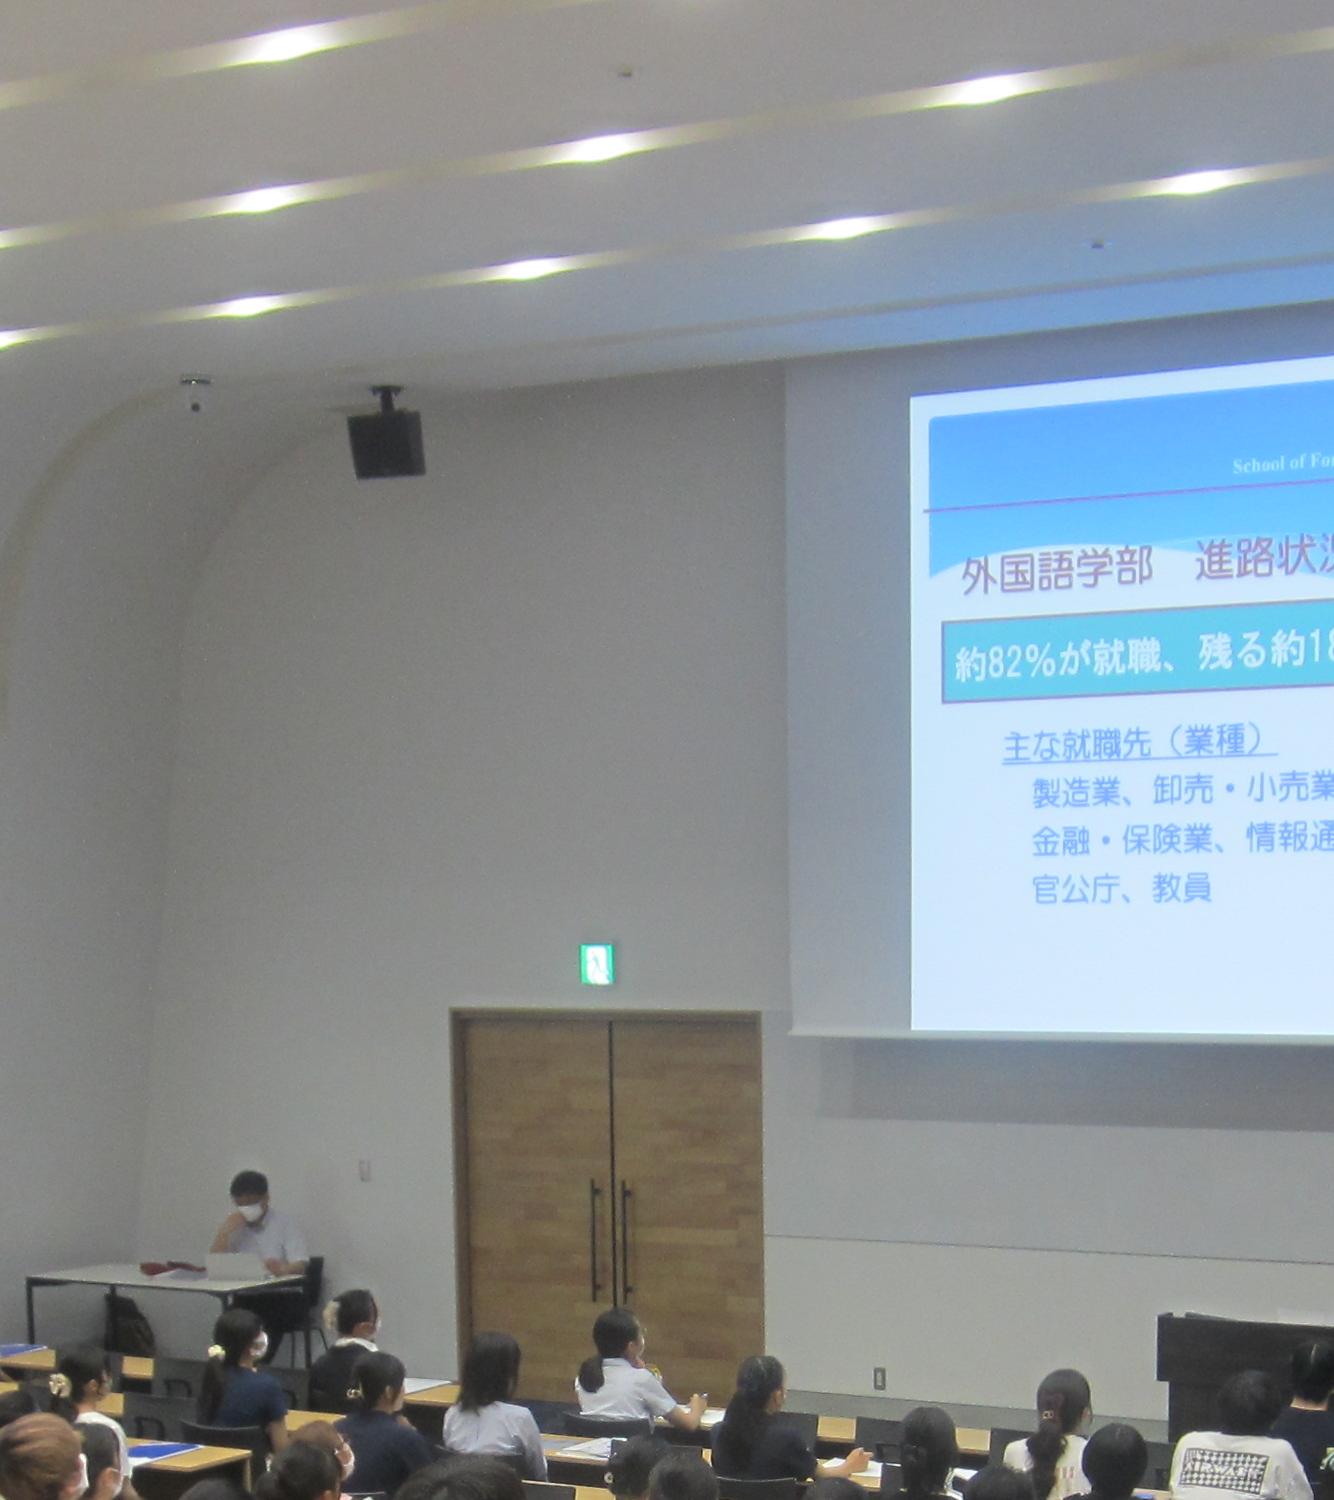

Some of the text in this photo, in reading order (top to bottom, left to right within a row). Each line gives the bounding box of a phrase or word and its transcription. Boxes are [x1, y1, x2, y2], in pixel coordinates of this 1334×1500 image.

[1233, 455, 1285, 475] School
[1290, 453, 1307, 470] of
[962, 545, 1154, 596] 外国語学部
[1032, 871, 1213, 905] 官公庁、教員
